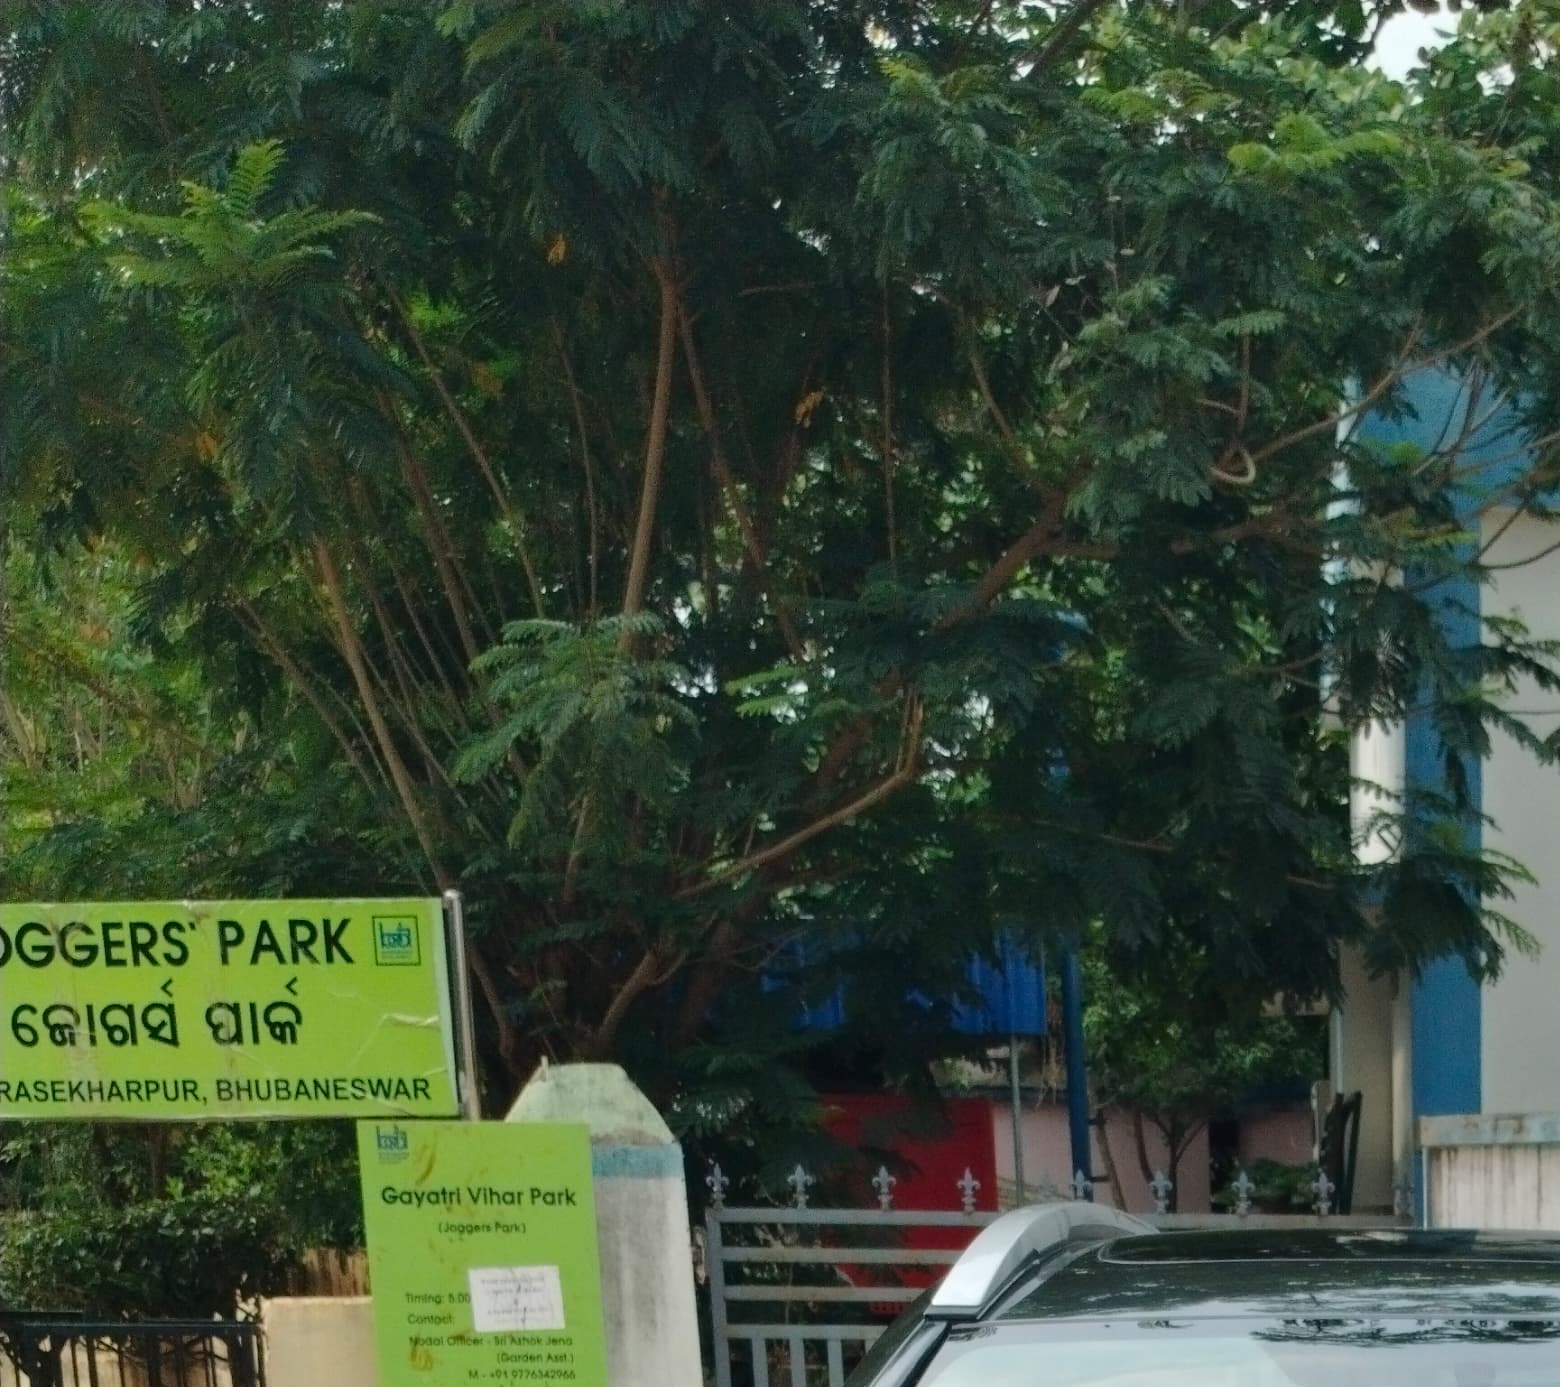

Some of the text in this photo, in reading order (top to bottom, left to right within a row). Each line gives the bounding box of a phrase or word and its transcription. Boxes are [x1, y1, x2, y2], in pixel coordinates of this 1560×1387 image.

[0, 918, 355, 969] GGERS' PARK
[204, 975, 303, 1046] ପାର୍କ
[215, 1077, 433, 1102] BHUBANESWAR
[381, 1186, 577, 1208] Gayatri Vihar Park
[438, 1221, 527, 1235] (Joggers Park)
[405, 1292, 445, 1306] Timing:
[468, 1369, 480, 1380] M
